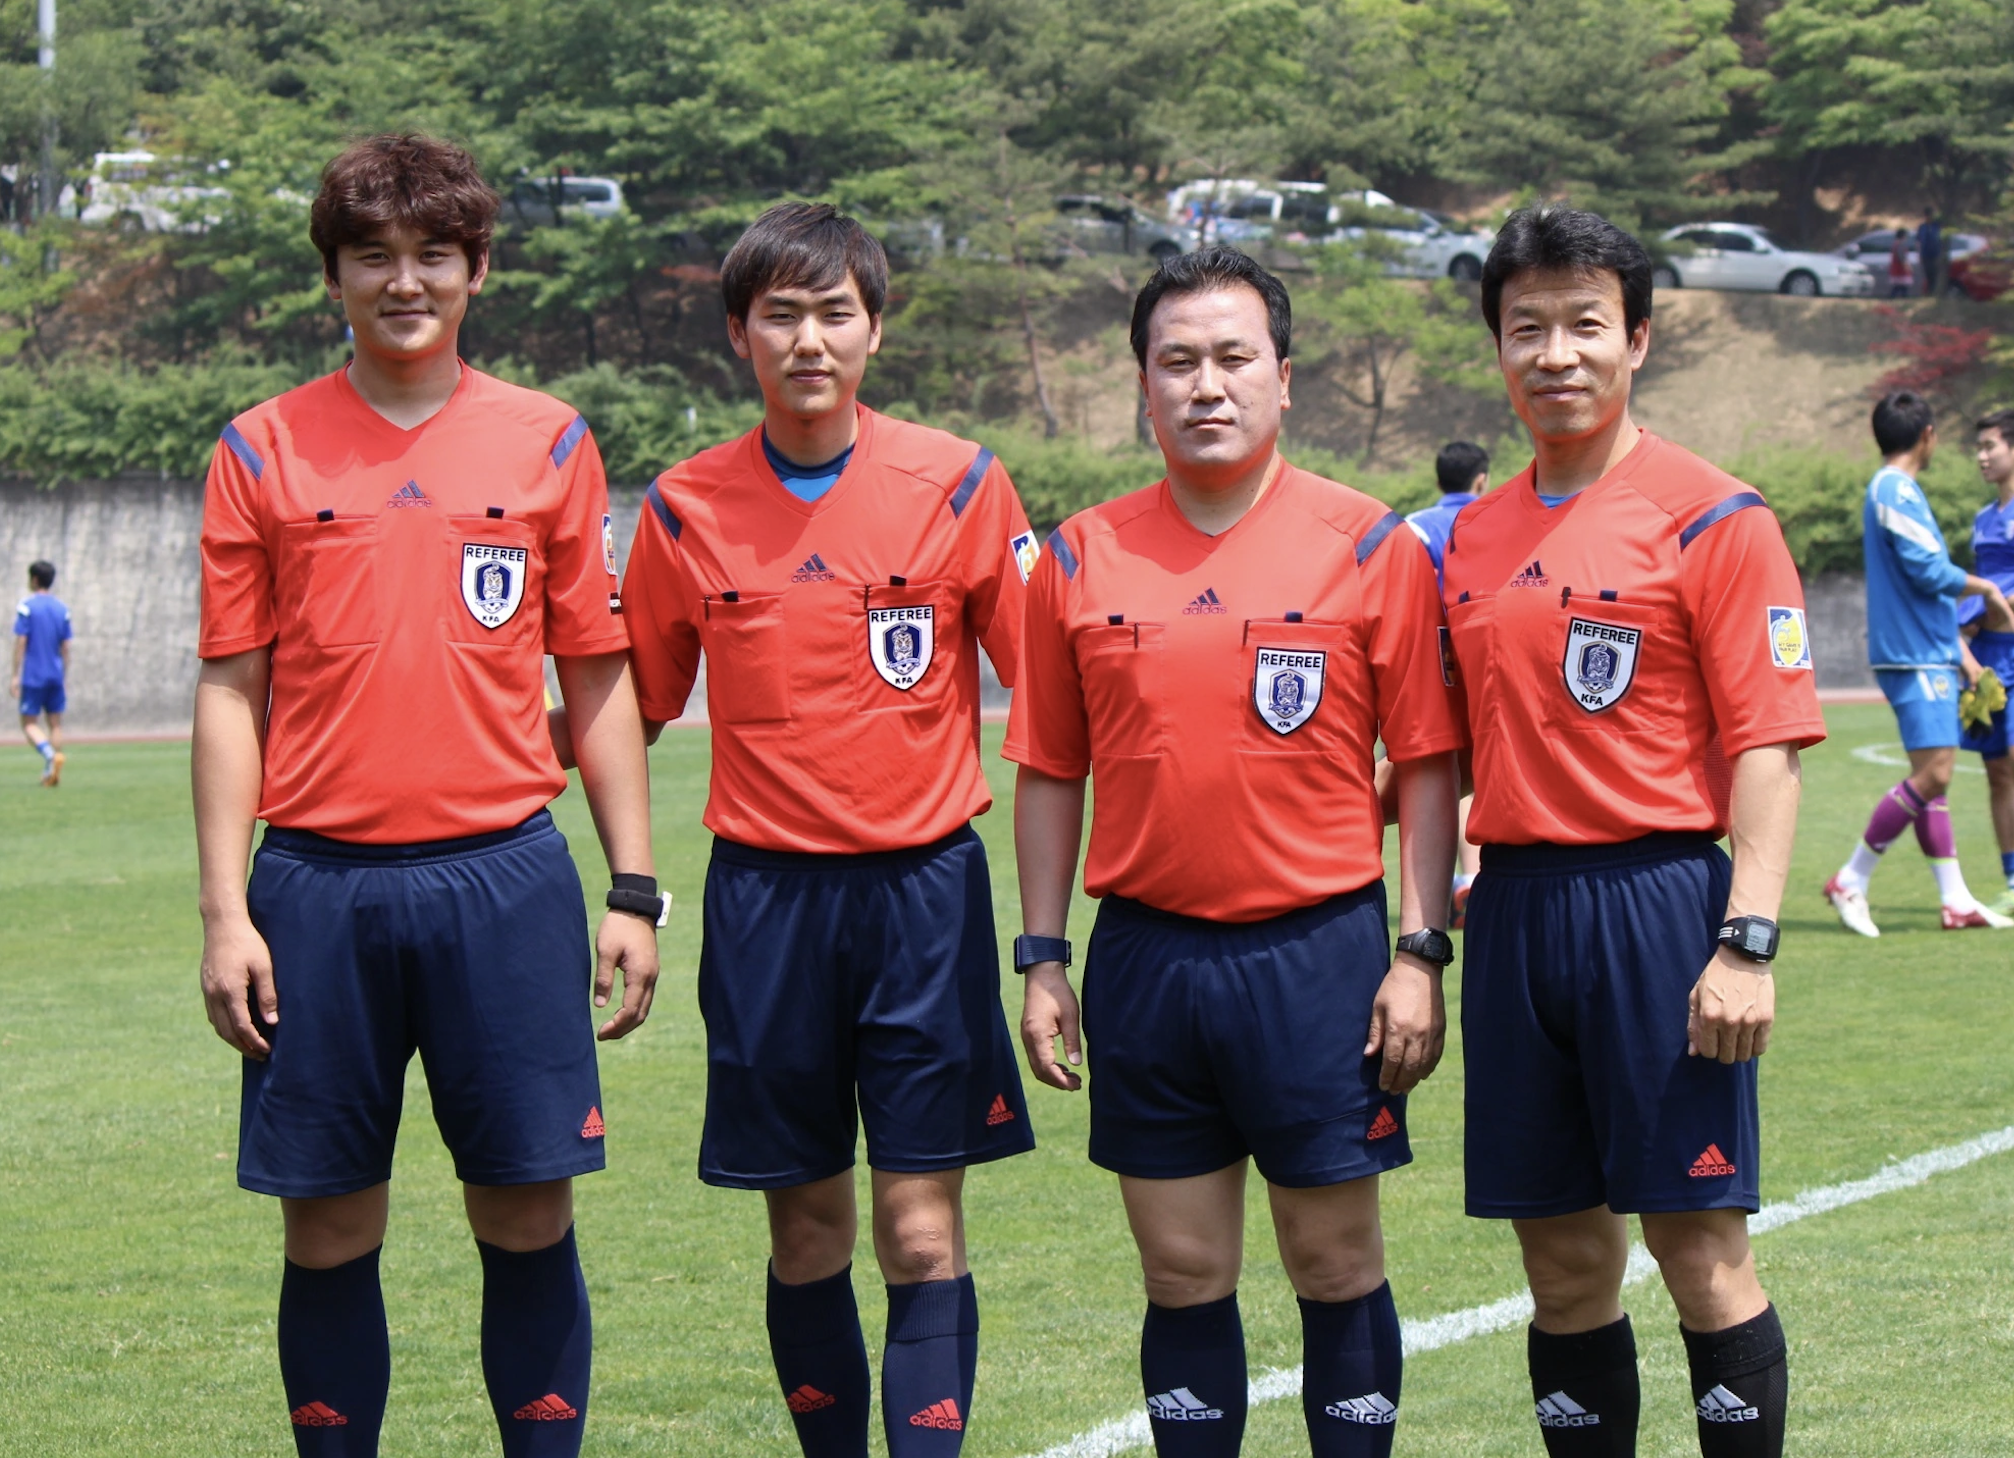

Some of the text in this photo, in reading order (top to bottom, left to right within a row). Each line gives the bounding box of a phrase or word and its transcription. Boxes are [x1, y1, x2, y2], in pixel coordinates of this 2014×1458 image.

[387, 498, 432, 508] adidas
[466, 547, 525, 562] REFEREE
[791, 571, 835, 583] adidas
[1511, 576, 1549, 588] adidas
[871, 608, 932, 623] REFEREE
[1182, 604, 1227, 615] adidas
[482, 615, 500, 623] KFA
[1573, 622, 1636, 645] REFEREE
[1260, 653, 1321, 668] REFEREE
[1581, 693, 1604, 706] KFA
[986, 1110, 1015, 1125] adidas
[1366, 1121, 1399, 1140] adidas
[1688, 1163, 1736, 1177] adidas
[788, 1394, 836, 1413] didas
[513, 1407, 577, 1421] adidas
[1537, 1412, 1601, 1427] didas
[1696, 1405, 1760, 1422] adidas
[909, 1413, 963, 1431] adidas
